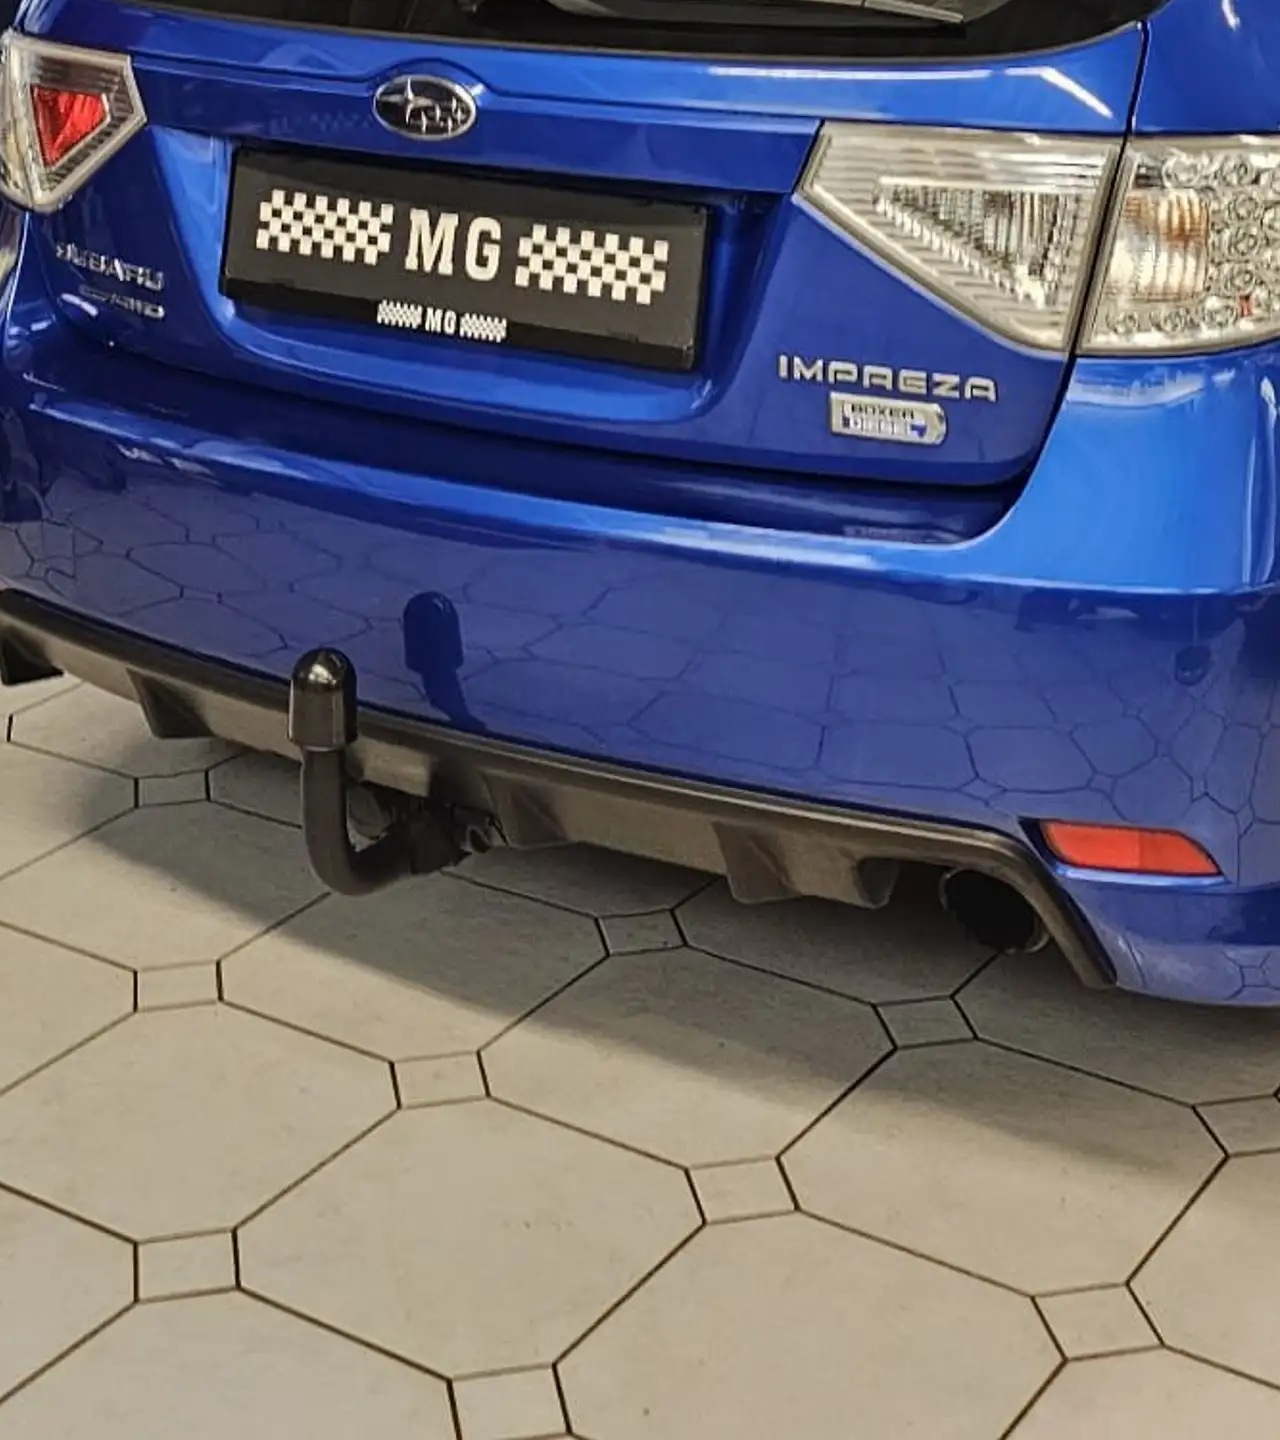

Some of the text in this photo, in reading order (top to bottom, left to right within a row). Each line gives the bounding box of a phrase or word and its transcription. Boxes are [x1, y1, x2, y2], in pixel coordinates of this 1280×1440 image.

[56, 242, 165, 292] SUBARU
[405, 207, 502, 281] MG
[425, 307, 457, 335] MG
[778, 354, 998, 402] IMPREZA
[848, 402, 915, 420] BOXER
